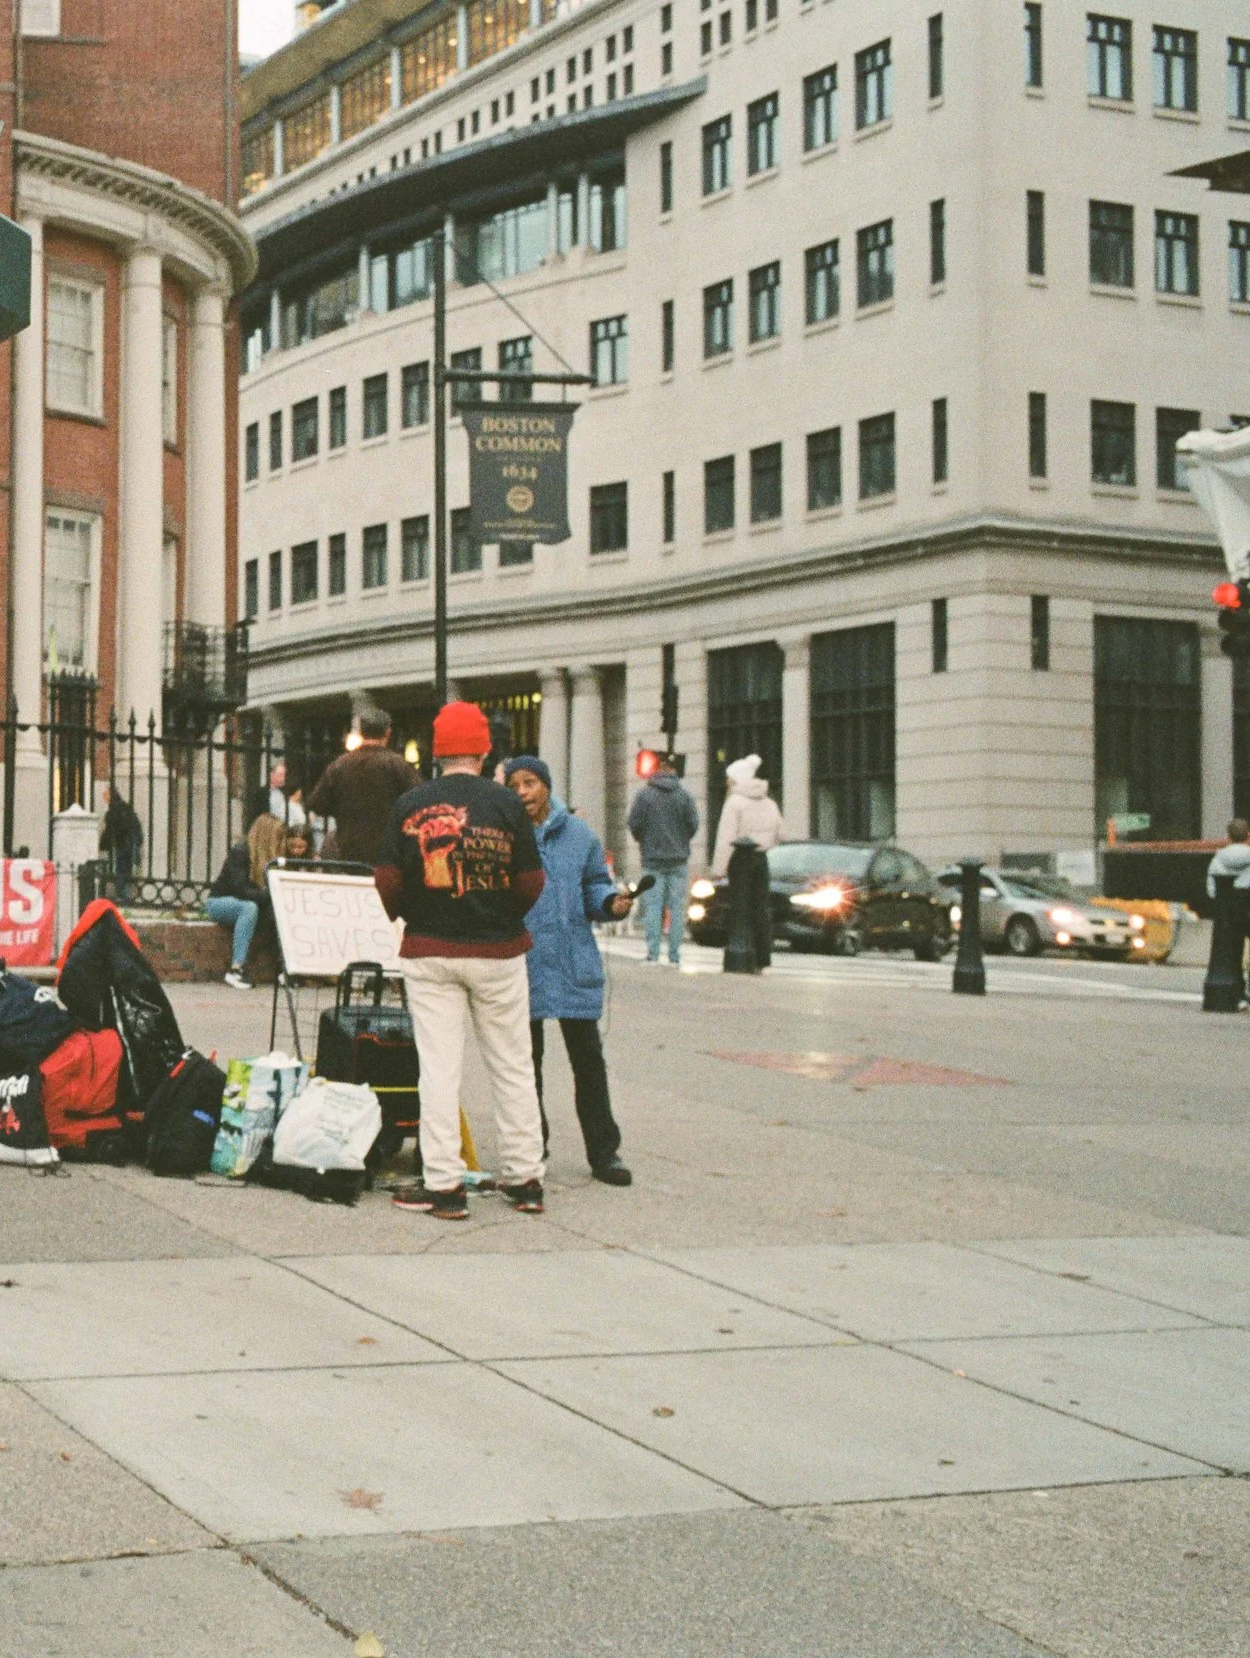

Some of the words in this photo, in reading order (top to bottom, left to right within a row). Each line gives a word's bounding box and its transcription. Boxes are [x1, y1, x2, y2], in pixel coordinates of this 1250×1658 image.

[481, 417, 555, 432] BOSTON
[475, 435, 562, 452] COMMON
[282, 887, 385, 919] JESUS
[16, 928, 39, 945] LIFE
[291, 924, 395, 960] SAVES
